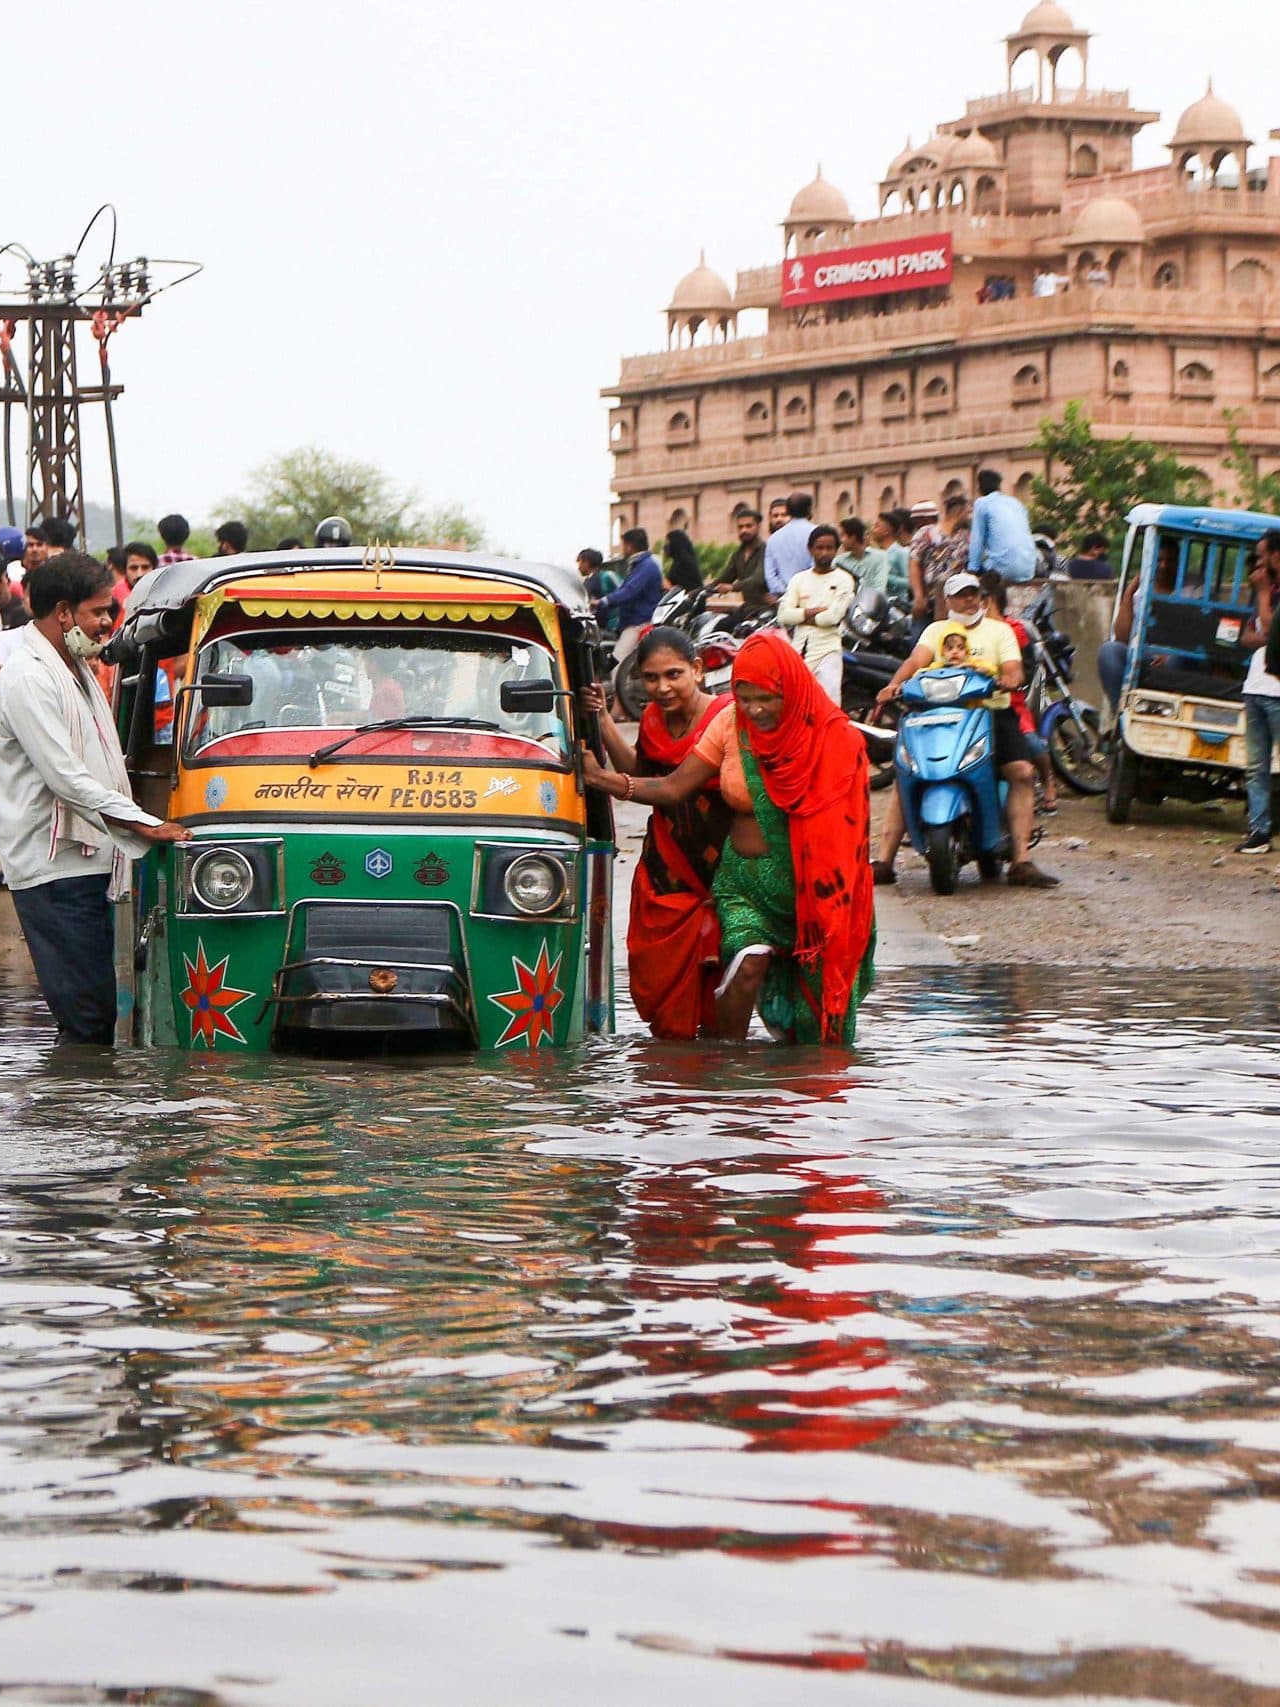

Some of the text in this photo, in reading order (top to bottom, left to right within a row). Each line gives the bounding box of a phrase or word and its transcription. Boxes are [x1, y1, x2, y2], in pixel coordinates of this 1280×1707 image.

[814, 248, 947, 288] CRIMSON PARK
[254, 776, 384, 801] नगरीय सेवा
